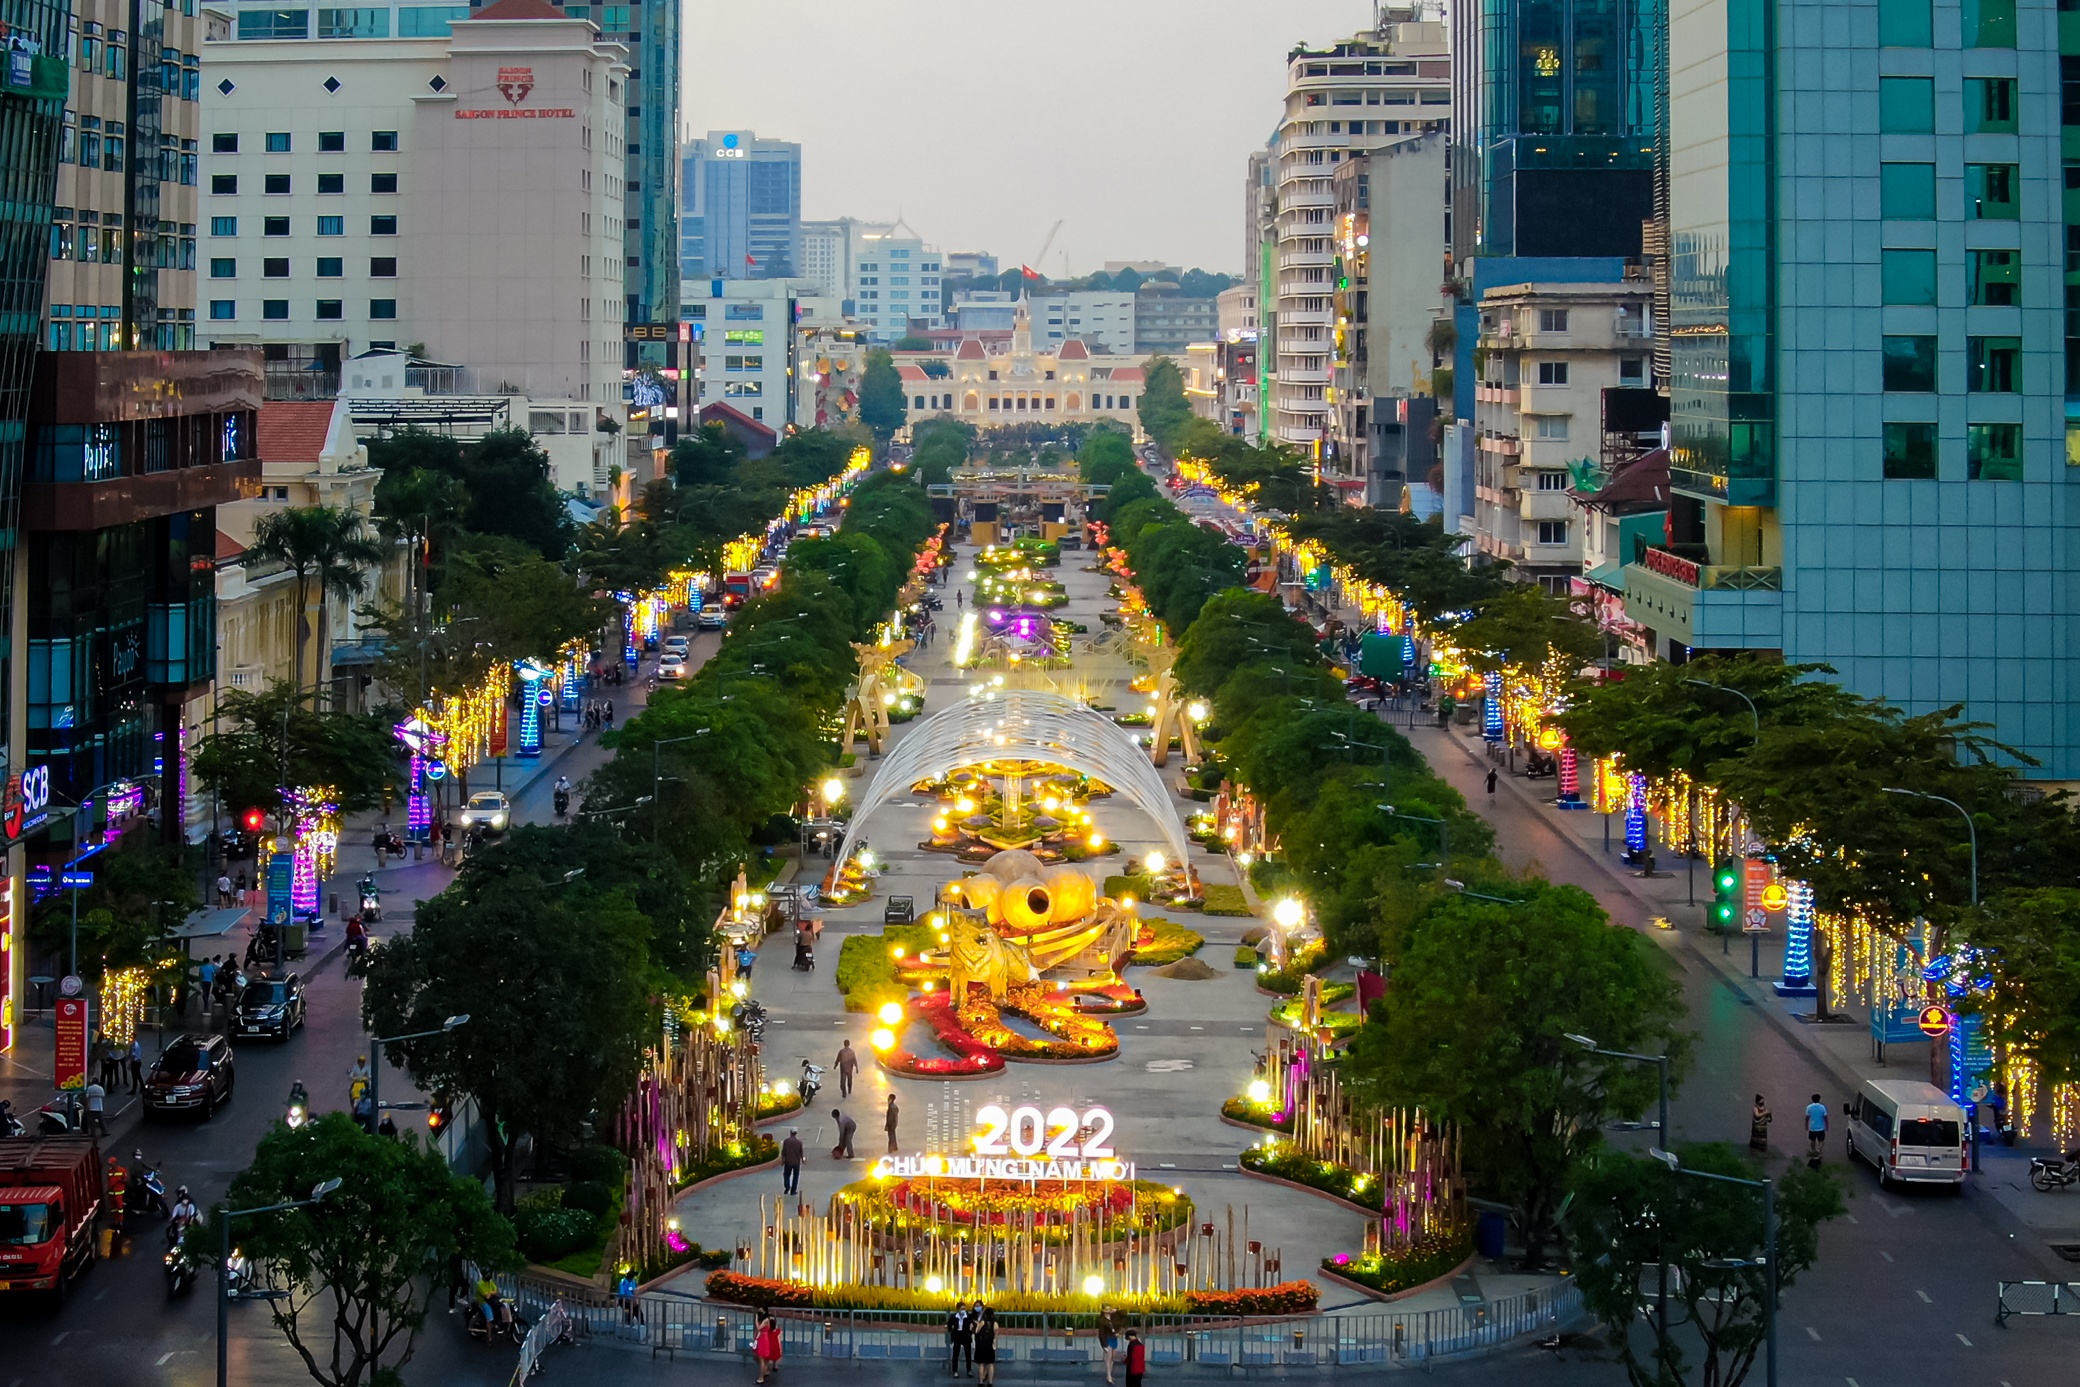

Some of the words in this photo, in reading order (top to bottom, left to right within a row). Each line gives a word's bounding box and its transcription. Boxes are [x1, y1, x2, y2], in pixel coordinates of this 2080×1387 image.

[455, 110, 495, 119] SAIGON
[497, 110, 536, 119] PRINCE
[538, 109, 575, 118] HOTEL
[716, 149, 743, 158] CCB
[23, 765, 49, 814] SCB
[975, 1104, 1115, 1157] 2022
[878, 1153, 942, 1176] CHÚ
[948, 1152, 1018, 1178] MỪNG
[1031, 1155, 1083, 1179] NĂM
